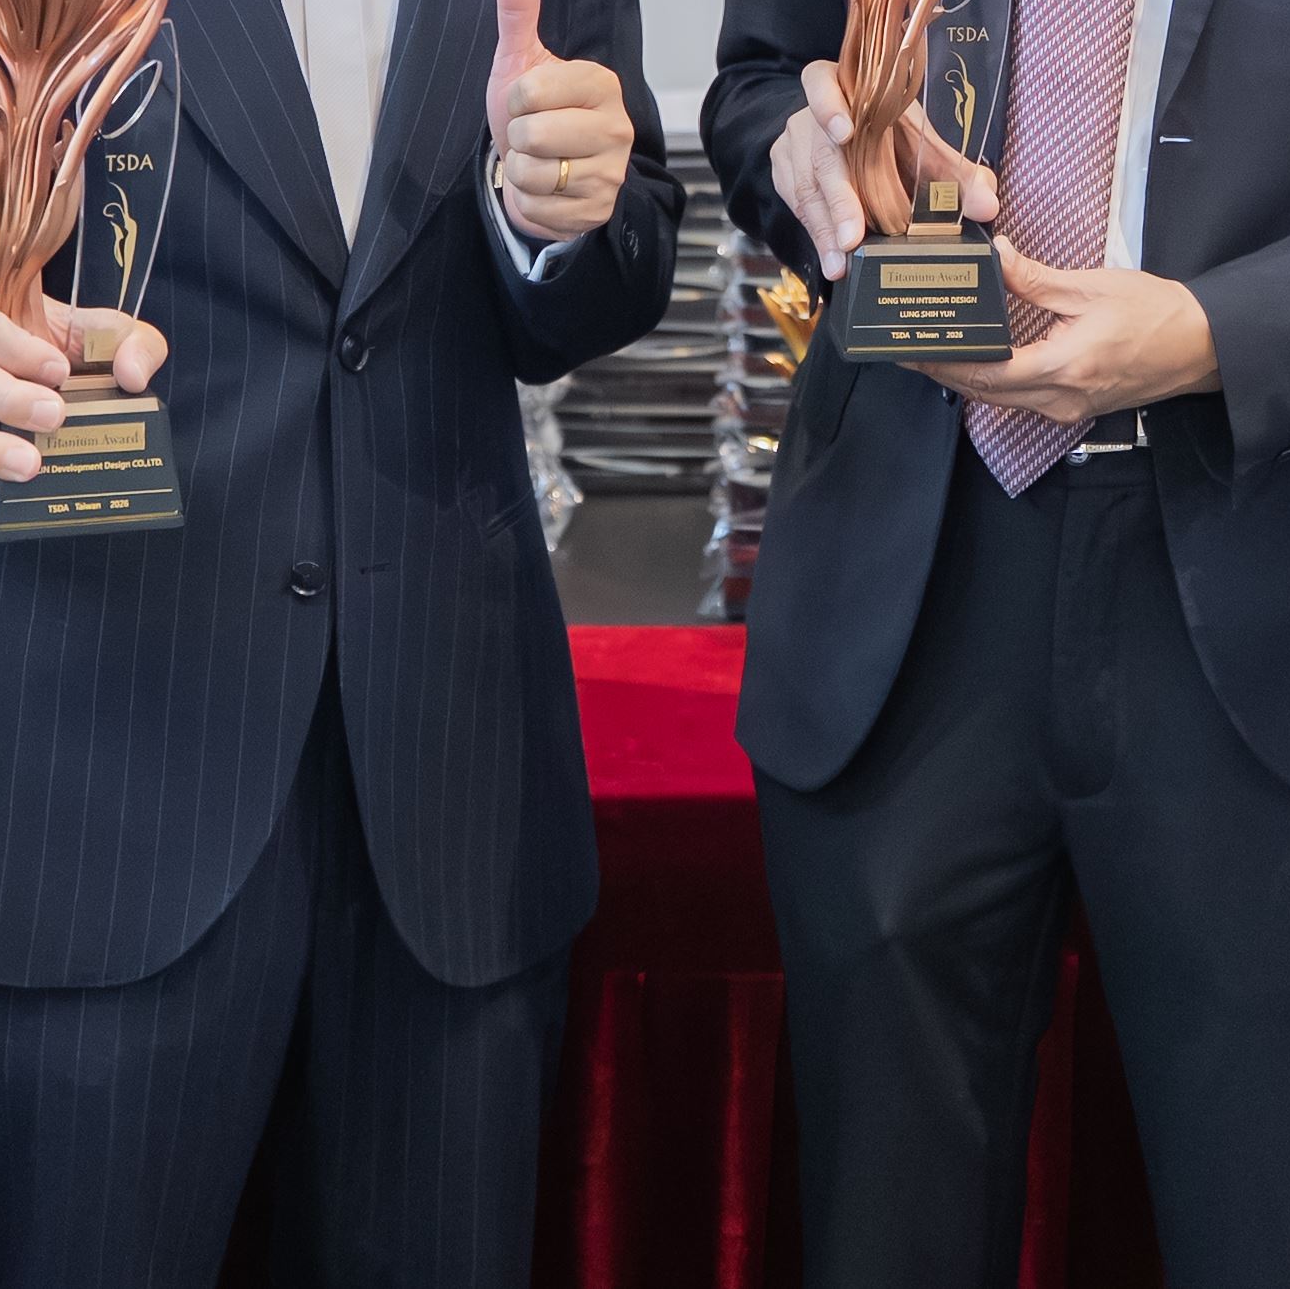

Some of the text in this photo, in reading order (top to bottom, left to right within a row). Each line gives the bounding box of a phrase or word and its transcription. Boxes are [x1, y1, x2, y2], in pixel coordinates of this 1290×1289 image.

[946, 26, 990, 43] TSDA
[105, 153, 154, 172] TSDA
[887, 270, 971, 283] Titanium Award
[878, 296, 978, 305] LONG WIN INTERIOR DESIGN
[899, 310, 920, 319] LUNG
[939, 310, 956, 318] YUN
[891, 331, 910, 340] TSDA
[915, 330, 940, 340] Taiwan
[46, 431, 139, 450] Titanium Award
[51, 463, 104, 474] Development
[104, 461, 131, 471] Design
[48, 503, 70, 513] TSDA
[75, 501, 102, 511] Taiwan
